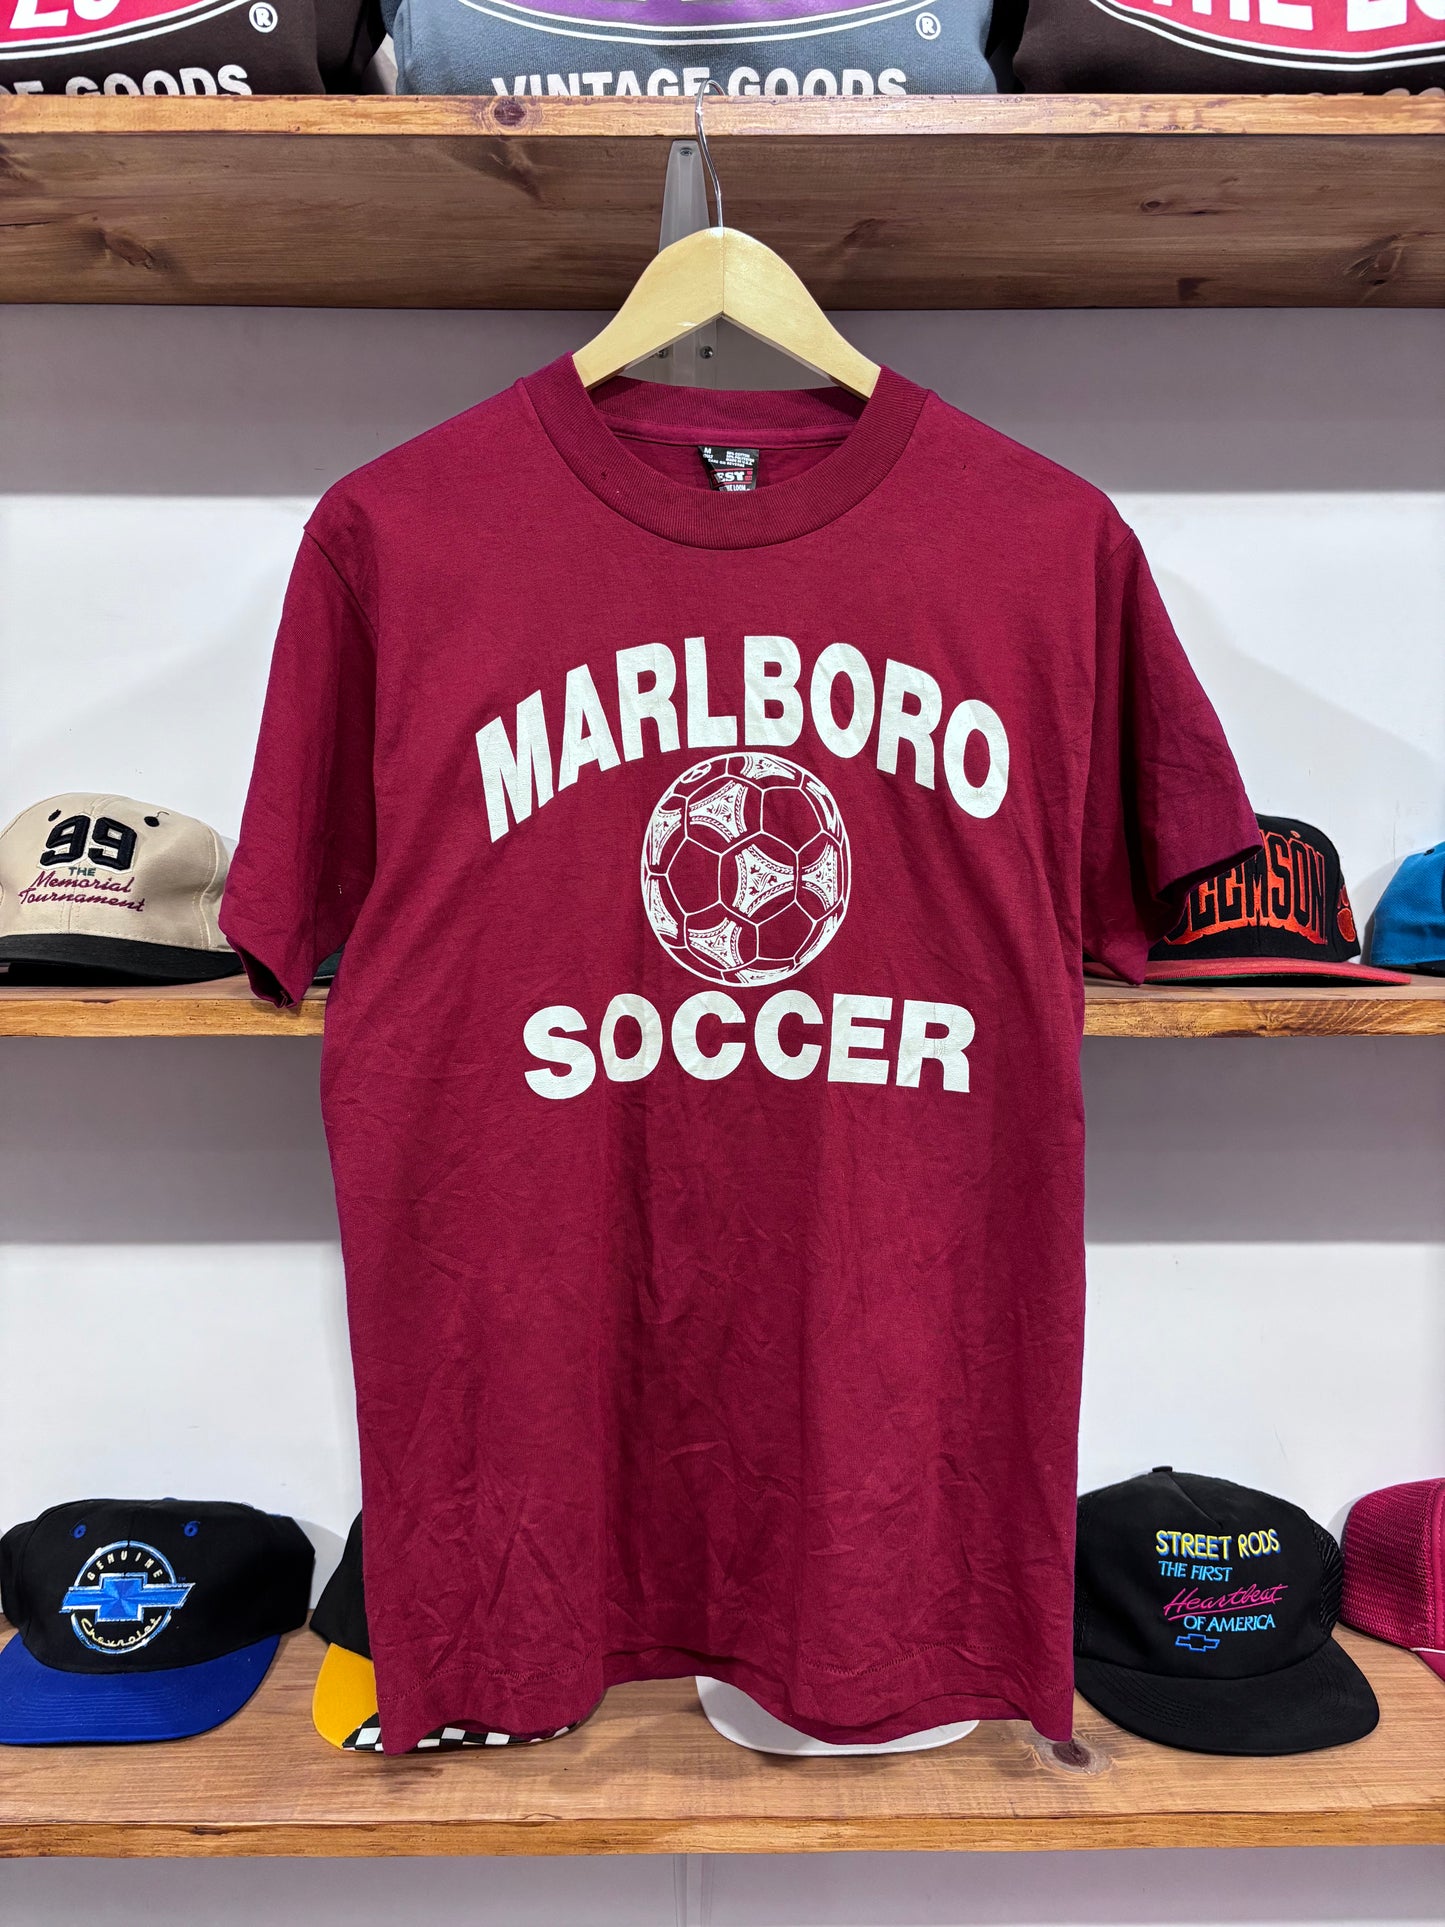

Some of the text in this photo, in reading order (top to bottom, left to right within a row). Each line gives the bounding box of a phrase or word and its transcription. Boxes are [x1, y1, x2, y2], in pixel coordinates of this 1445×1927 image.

[728, 66, 907, 96] GOODS
[714, 471, 745, 483] EST
[475, 635, 1010, 843] MARLBORO
[38, 813, 138, 873] 99
[31, 871, 135, 893] Memorial
[68, 866, 97, 877] THE
[18, 888, 146, 912] Tournament
[1163, 829, 1329, 946] LEMSON
[523, 989, 976, 1099] SOCCER
[1156, 1529, 1281, 1560] STREET RODS
[86, 1550, 163, 1581] GENUINE
[1158, 1560, 1233, 1582] THE FIRST
[1163, 1584, 1289, 1617] Heartbeat
[80, 1614, 164, 1648] Chevrolet
[1183, 1614, 1276, 1632] OF AMERICA
